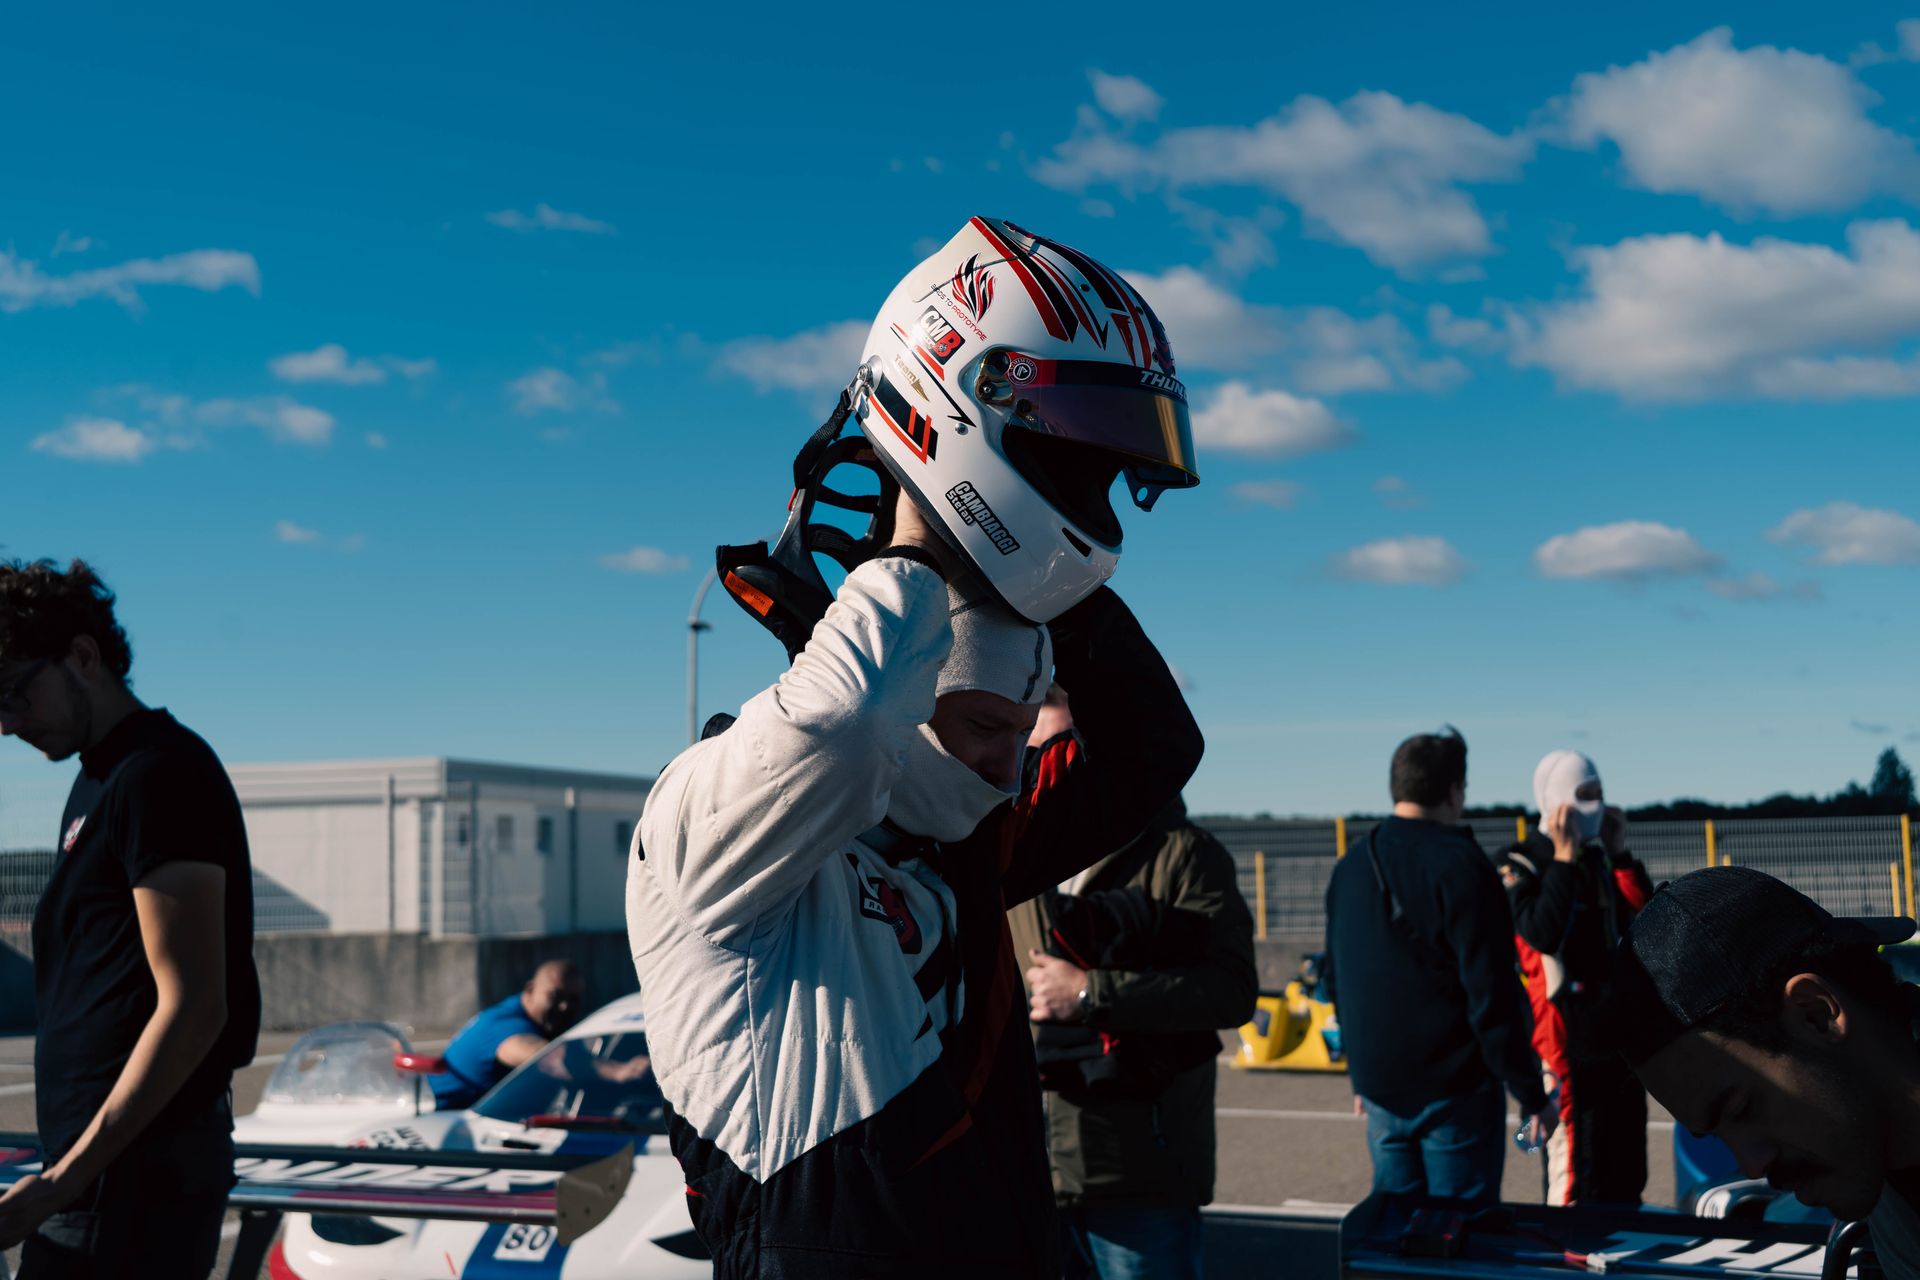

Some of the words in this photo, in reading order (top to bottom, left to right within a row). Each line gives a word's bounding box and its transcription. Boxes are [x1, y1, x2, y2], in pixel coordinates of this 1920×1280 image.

[920, 310, 961, 357] CMB
[951, 304, 988, 342] PROTOTYPE
[1140, 370, 1187, 400] THUN
[954, 482, 1018, 554] CAMBIAGGI
